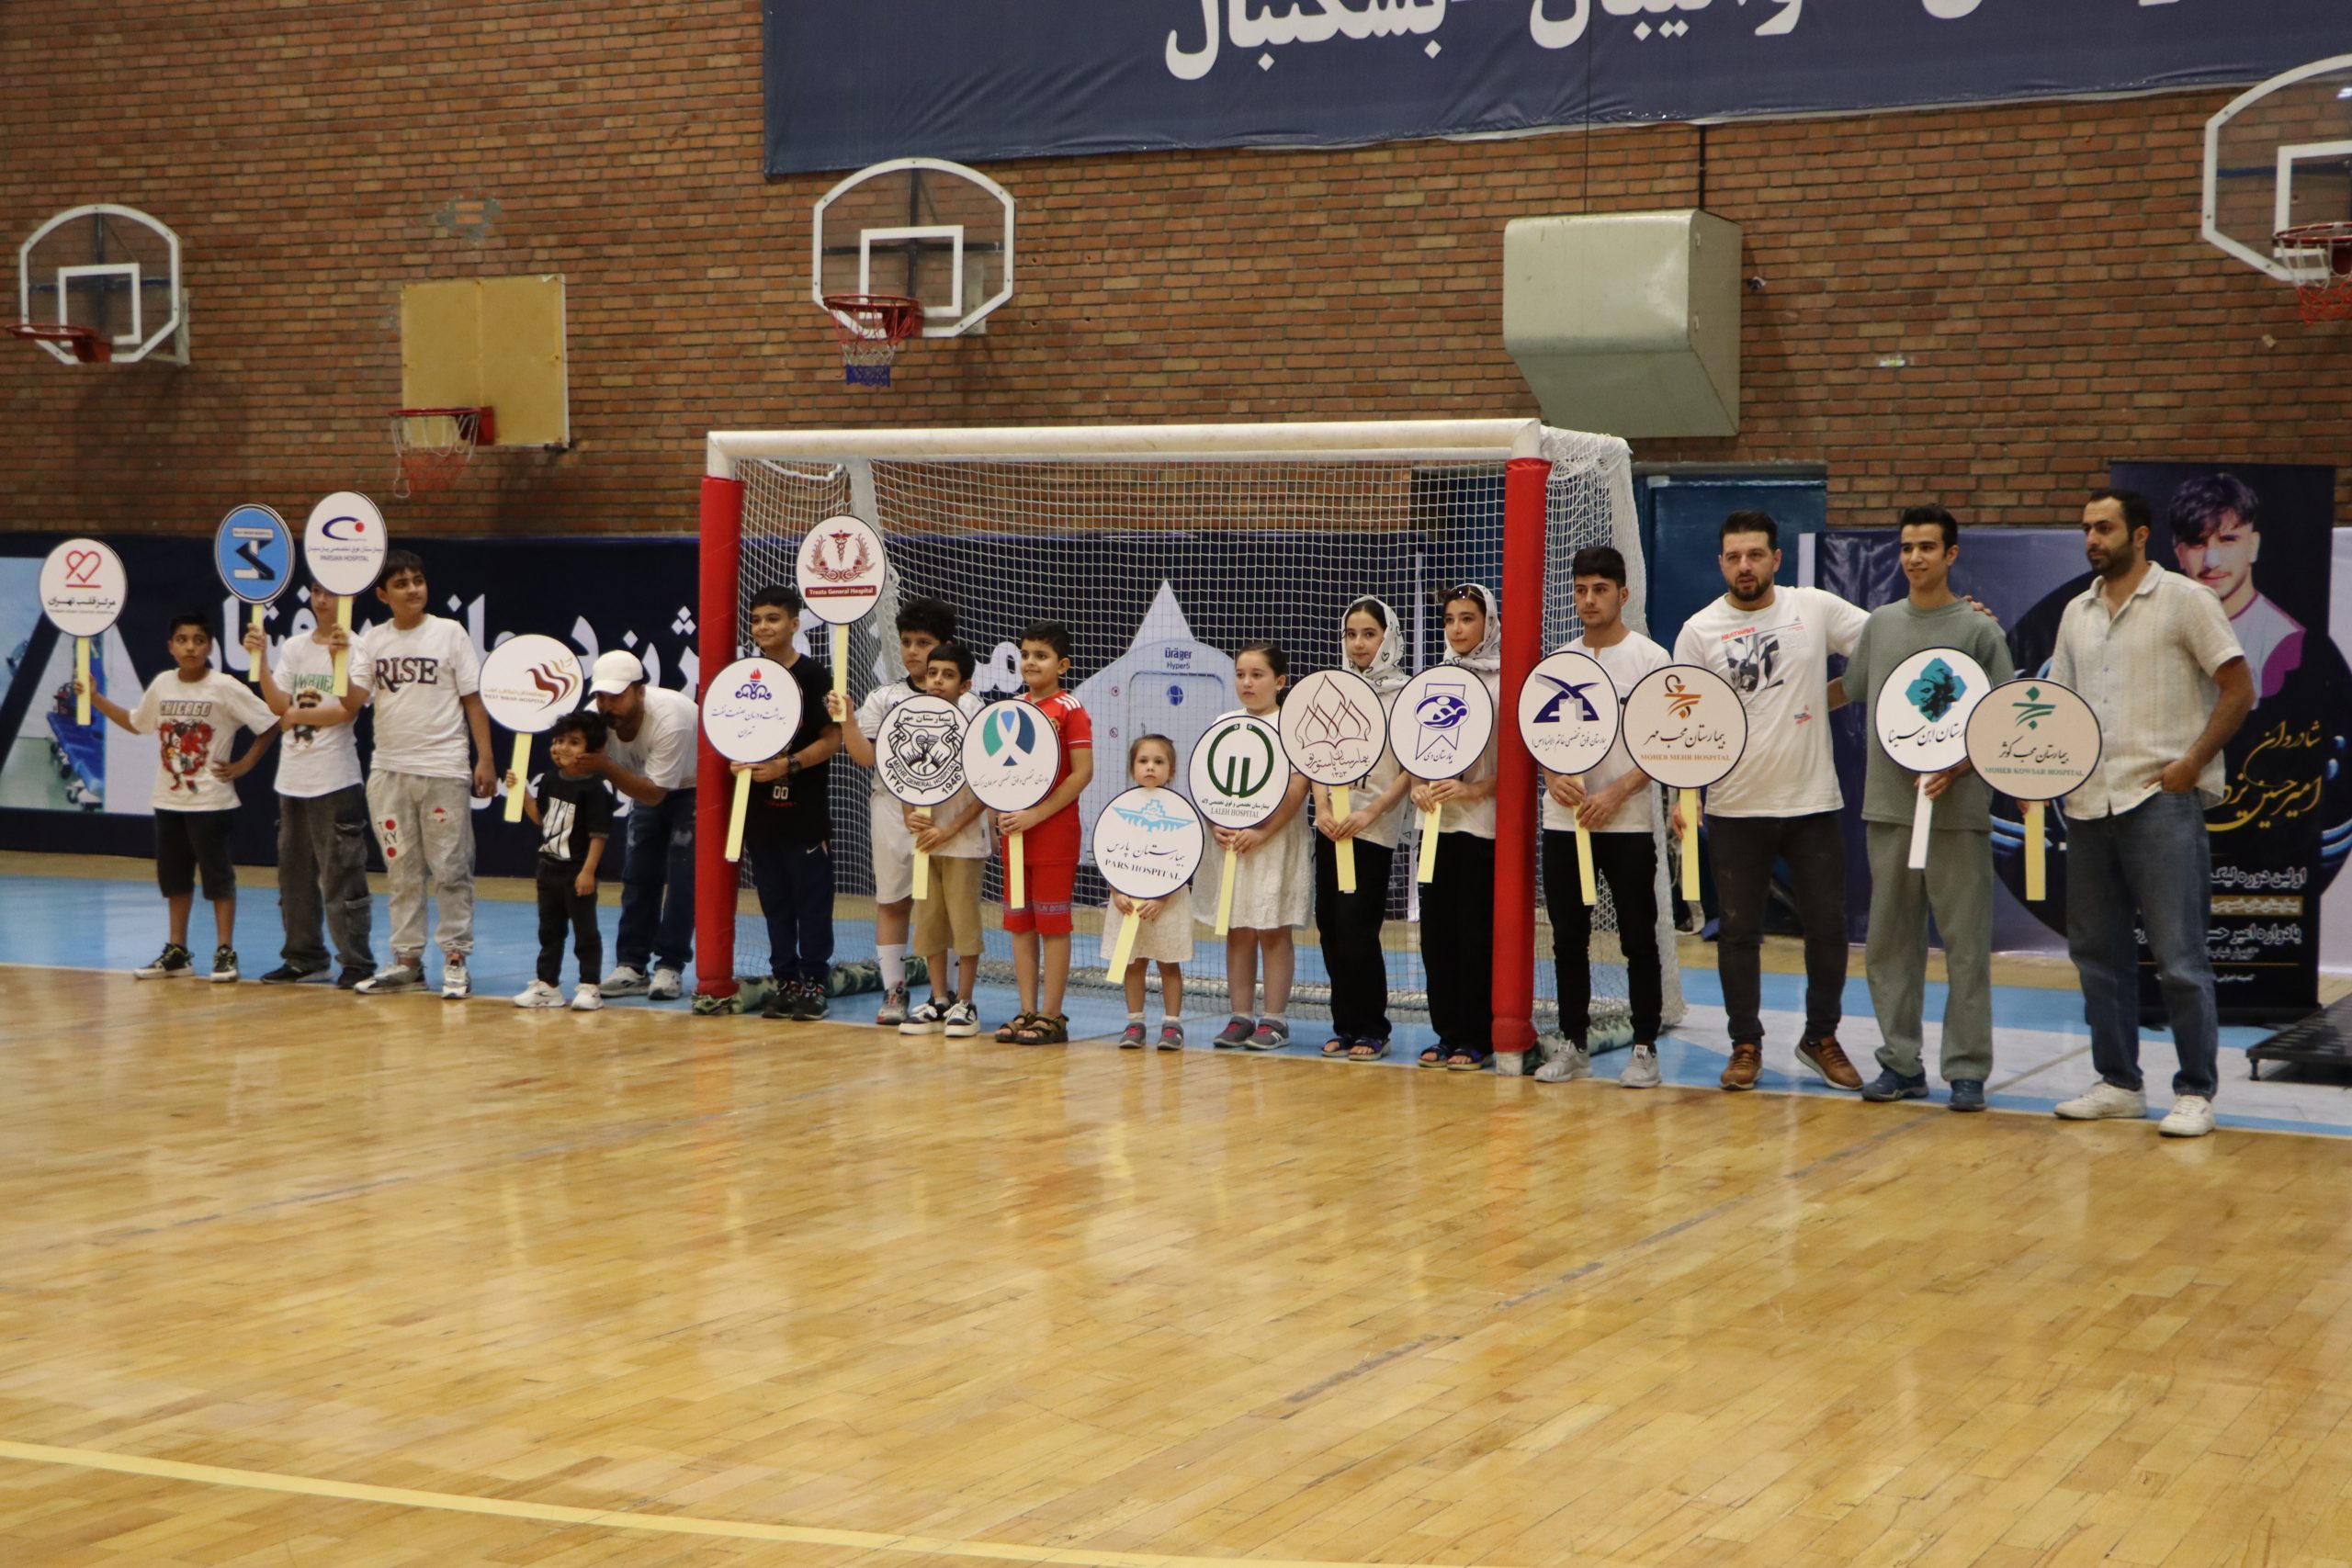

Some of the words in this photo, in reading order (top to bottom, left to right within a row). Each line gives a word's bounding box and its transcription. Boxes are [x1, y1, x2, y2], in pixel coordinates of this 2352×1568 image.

[851, 587, 874, 595] Hospital
[95, 597, 116, 608] مرکز
[1164, 647, 1193, 660] Dräger
[375, 656, 439, 693] RISE
[161, 700, 212, 716] CHICAGO
[916, 714, 952, 726] بیمارستان
[1643, 730, 1659, 746] مهر
[1660, 728, 1689, 749] محب
[1684, 724, 1725, 749] بیمارستان
[1888, 725, 1927, 748] سینا
[1917, 728, 1936, 746] ابن
[1999, 735, 2024, 758] کوثر
[2036, 744, 2069, 764] بیمارستان
[1334, 748, 1371, 769] بیمارستان
[1433, 750, 1453, 763] بیمارستان
[892, 759, 908, 778] MEHR
[906, 776, 933, 787] GENERAL
[933, 761, 957, 785] HOSPITAL
[773, 785, 789, 800] 00
[942, 773, 962, 795] 1946
[1210, 807, 1230, 816] LALEH
[1231, 808, 1260, 818] HOSPITAL
[1107, 840, 1130, 858] پارس
[1133, 843, 1185, 867] بیمارستان
[1104, 859, 1129, 871] PARS
[1131, 863, 1182, 881] HOSPITAL
